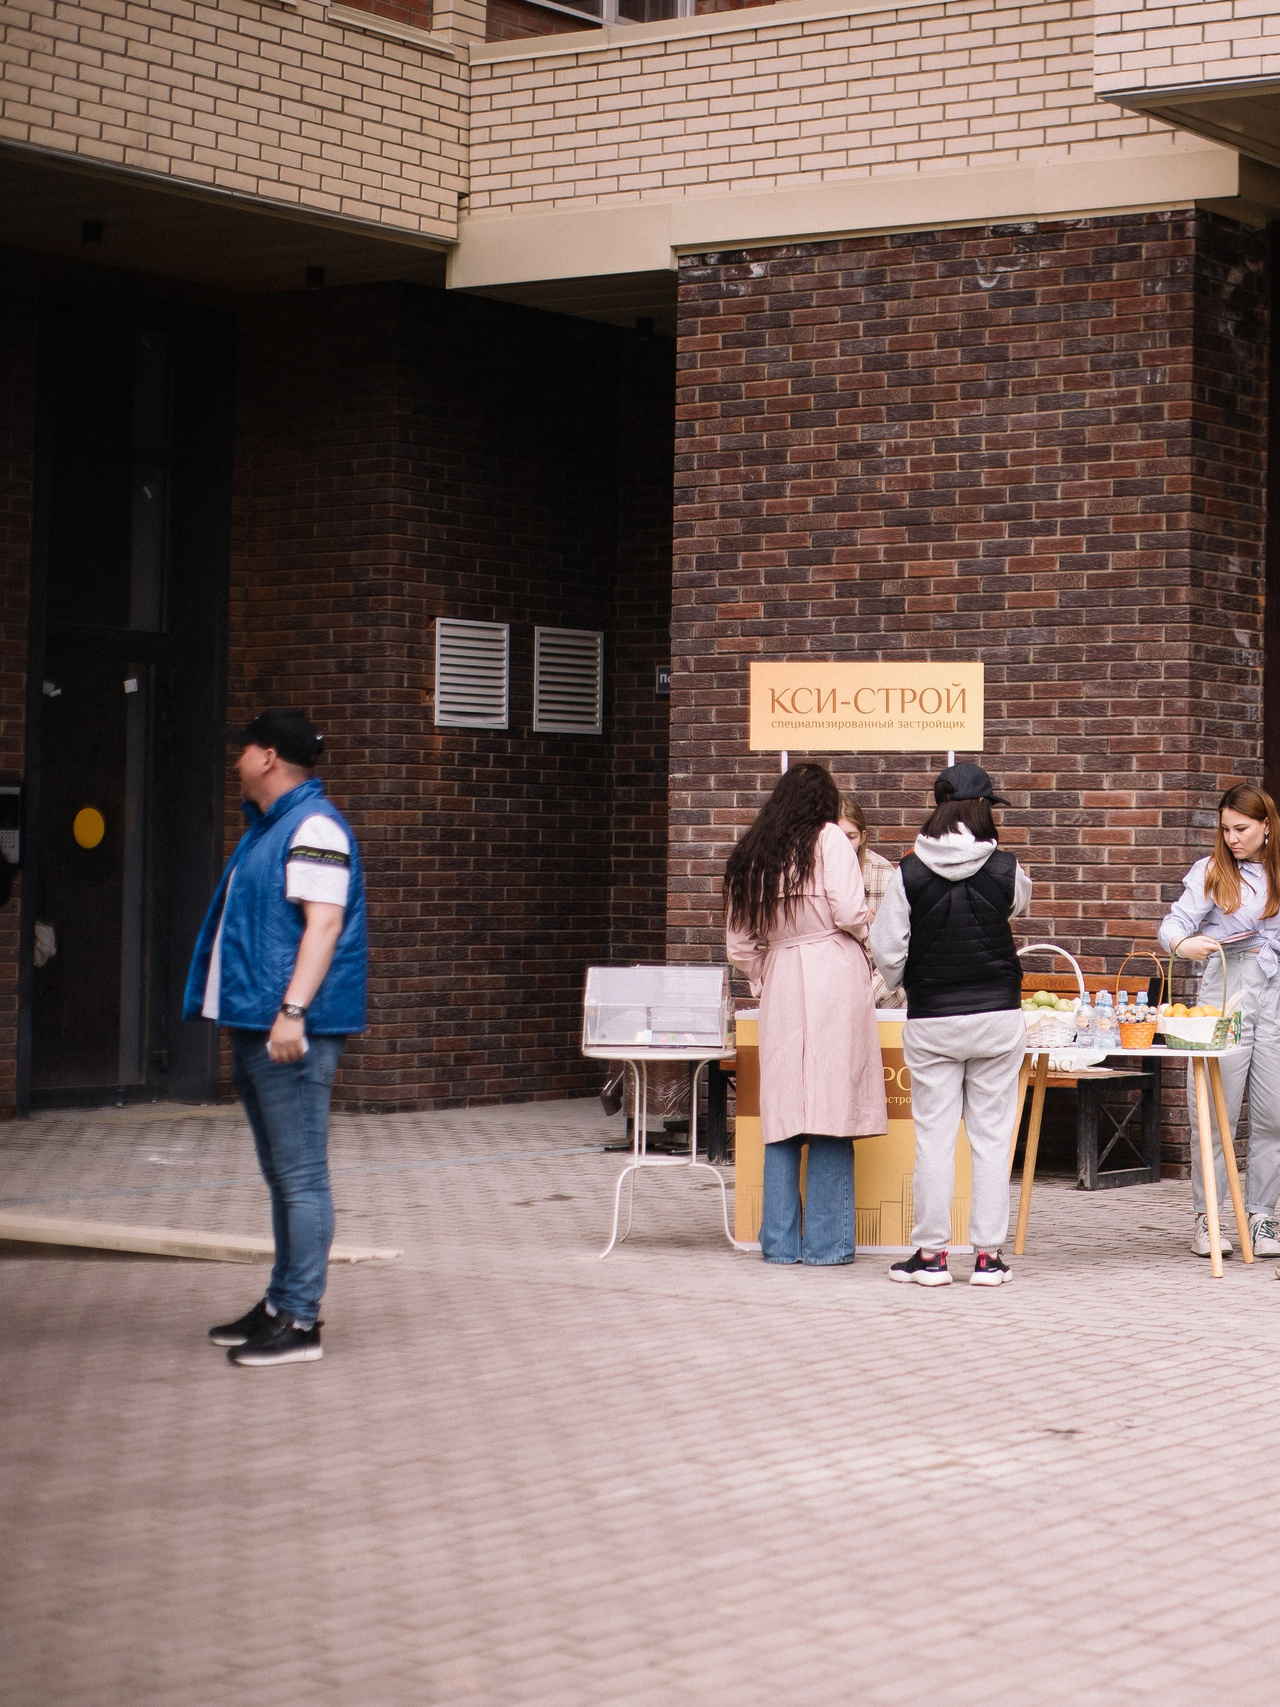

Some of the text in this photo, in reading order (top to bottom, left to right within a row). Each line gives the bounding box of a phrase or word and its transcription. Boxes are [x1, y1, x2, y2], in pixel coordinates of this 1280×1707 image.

[768, 682, 967, 715] КСИ-СТРОЙ
[771, 719, 966, 730] специализированный застройщик
